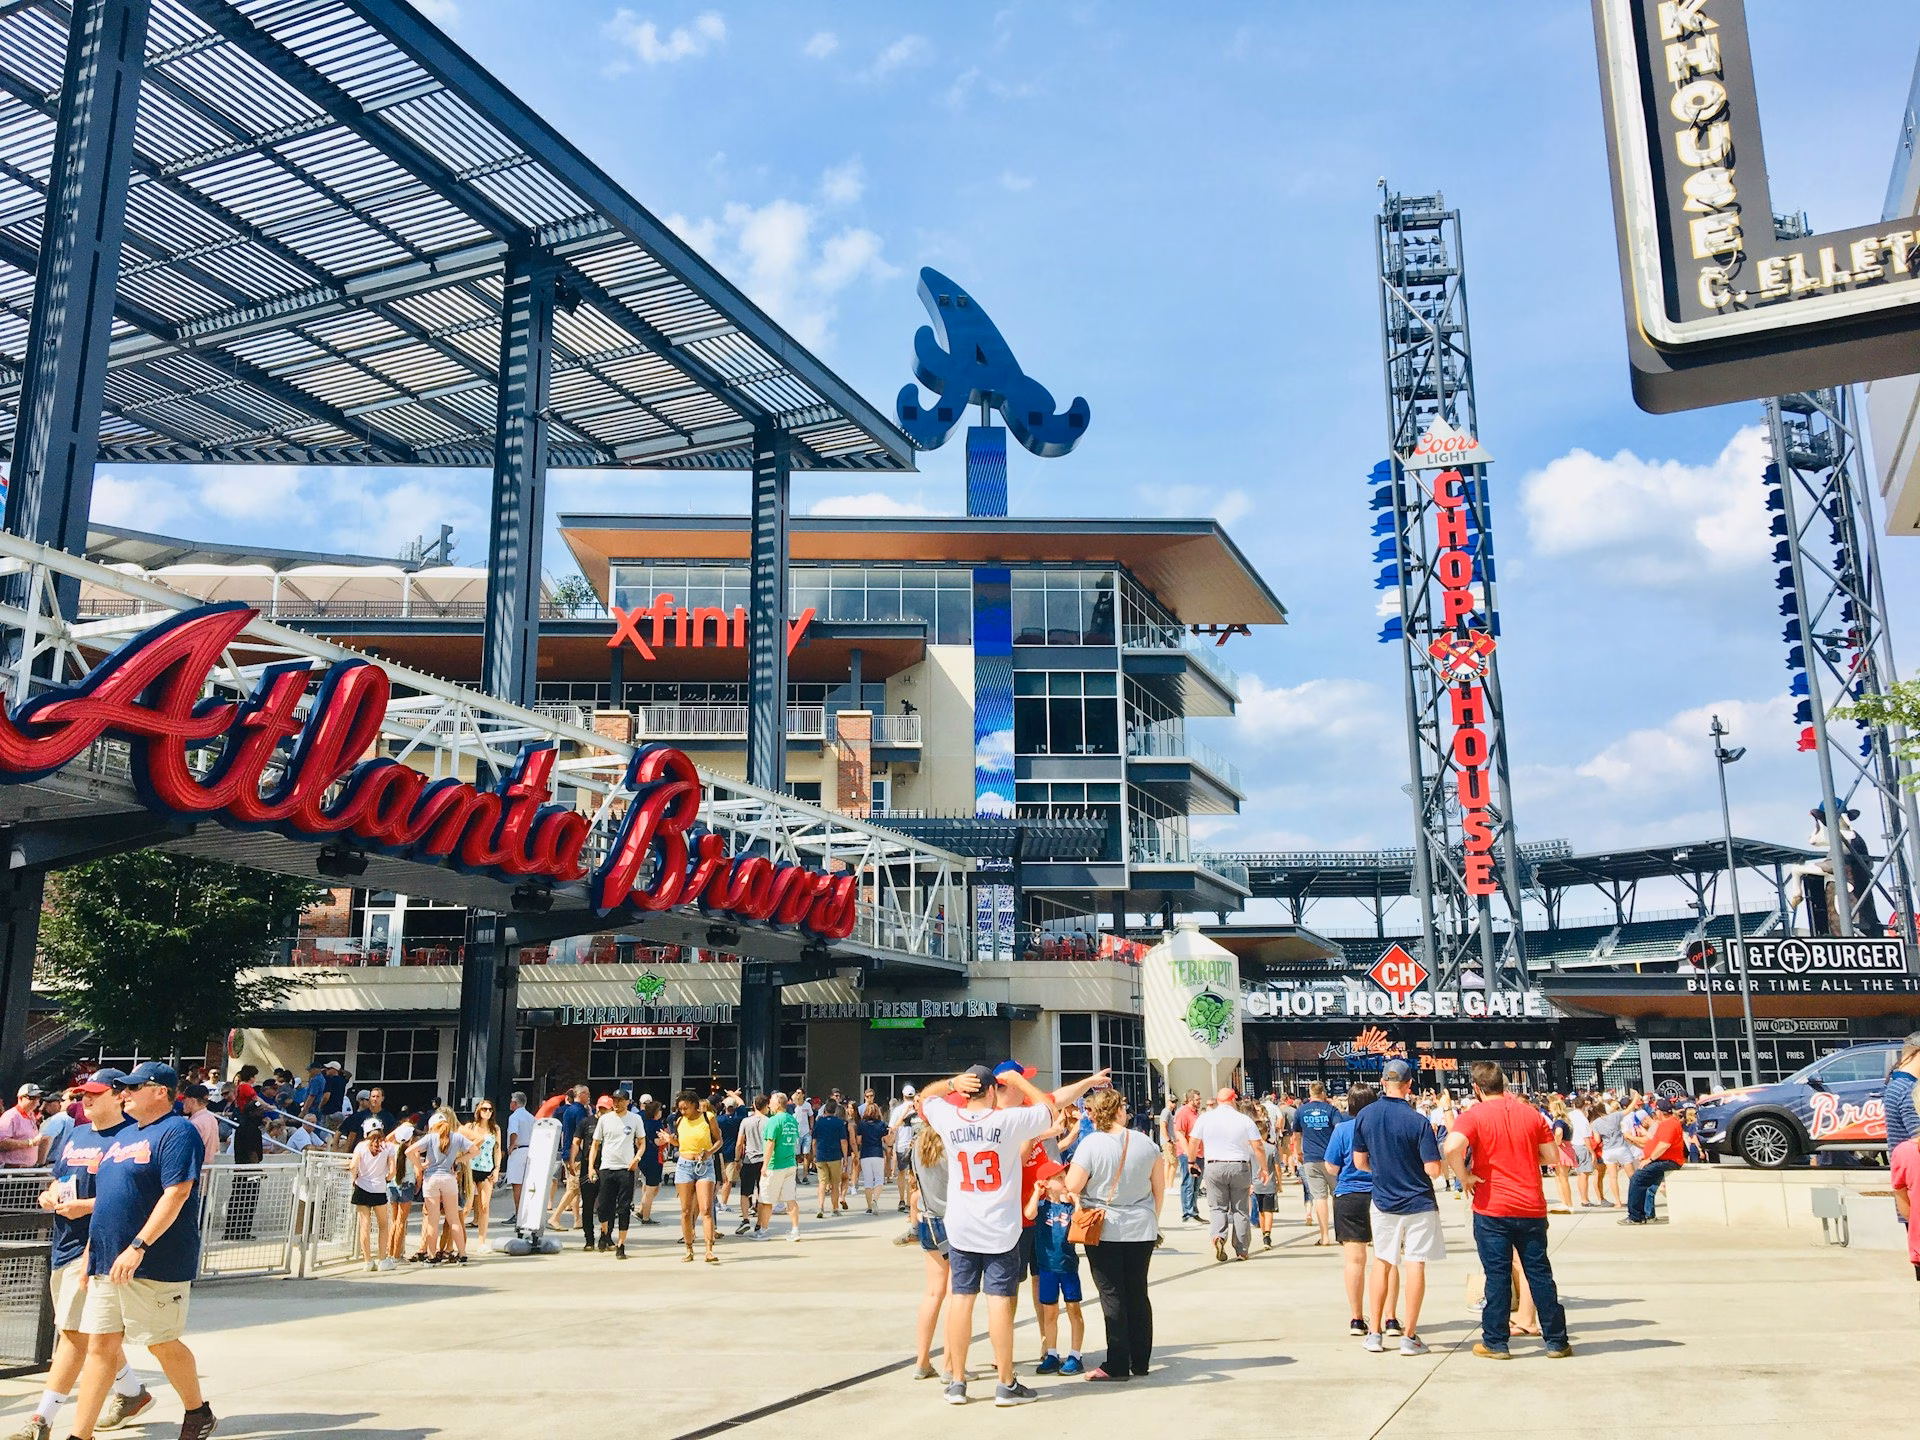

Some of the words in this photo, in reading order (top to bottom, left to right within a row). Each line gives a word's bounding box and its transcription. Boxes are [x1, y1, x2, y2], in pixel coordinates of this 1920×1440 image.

[1757, 230, 1920, 298] ELLET
[1414, 432, 1478, 455] Coors
[1427, 451, 1467, 464] LIGHT
[1433, 470, 1474, 627] CHOP
[607, 592, 816, 661] xfiniy
[0, 602, 590, 884] Atlanta
[593, 743, 857, 943] Braves
[1450, 687, 1498, 895] HOUSE
[1813, 944, 1901, 968] BURGER
[1381, 962, 1417, 987] CH
[1769, 979, 1812, 992] TIME
[1821, 979, 1854, 991] ALL
[1858, 979, 1894, 991] THE
[560, 1005, 646, 1025] TERRAPIN
[652, 1003, 733, 1024] TAPROOM
[800, 1002, 870, 1019] TERRAPIN
[873, 1000, 918, 1018] FRESH
[921, 1000, 963, 1018] BREW
[966, 1000, 998, 1018] BAR
[1247, 992, 1336, 1016] CHOP
[1346, 992, 1458, 1016] HOUSE
[1463, 992, 1542, 1016] GATE
[612, 1027, 629, 1036] FOX
[630, 1027, 655, 1036] BROS.
[657, 1026, 692, 1036] BAR-B-Q
[1773, 1020, 1796, 1032] OPEN
[1799, 1020, 1838, 1031] EVERYDAY
[1419, 1054, 1458, 1070] PARK
[1652, 1051, 1681, 1060] BURGERS
[1694, 1051, 1711, 1060] COLD
[1786, 1051, 1805, 1060] FRIES
[1303, 1115, 1329, 1123] COSTA
[950, 1124, 984, 1145] ACUÑA
[987, 1127, 1001, 1145] JR.
[957, 1150, 1002, 1192] 13
